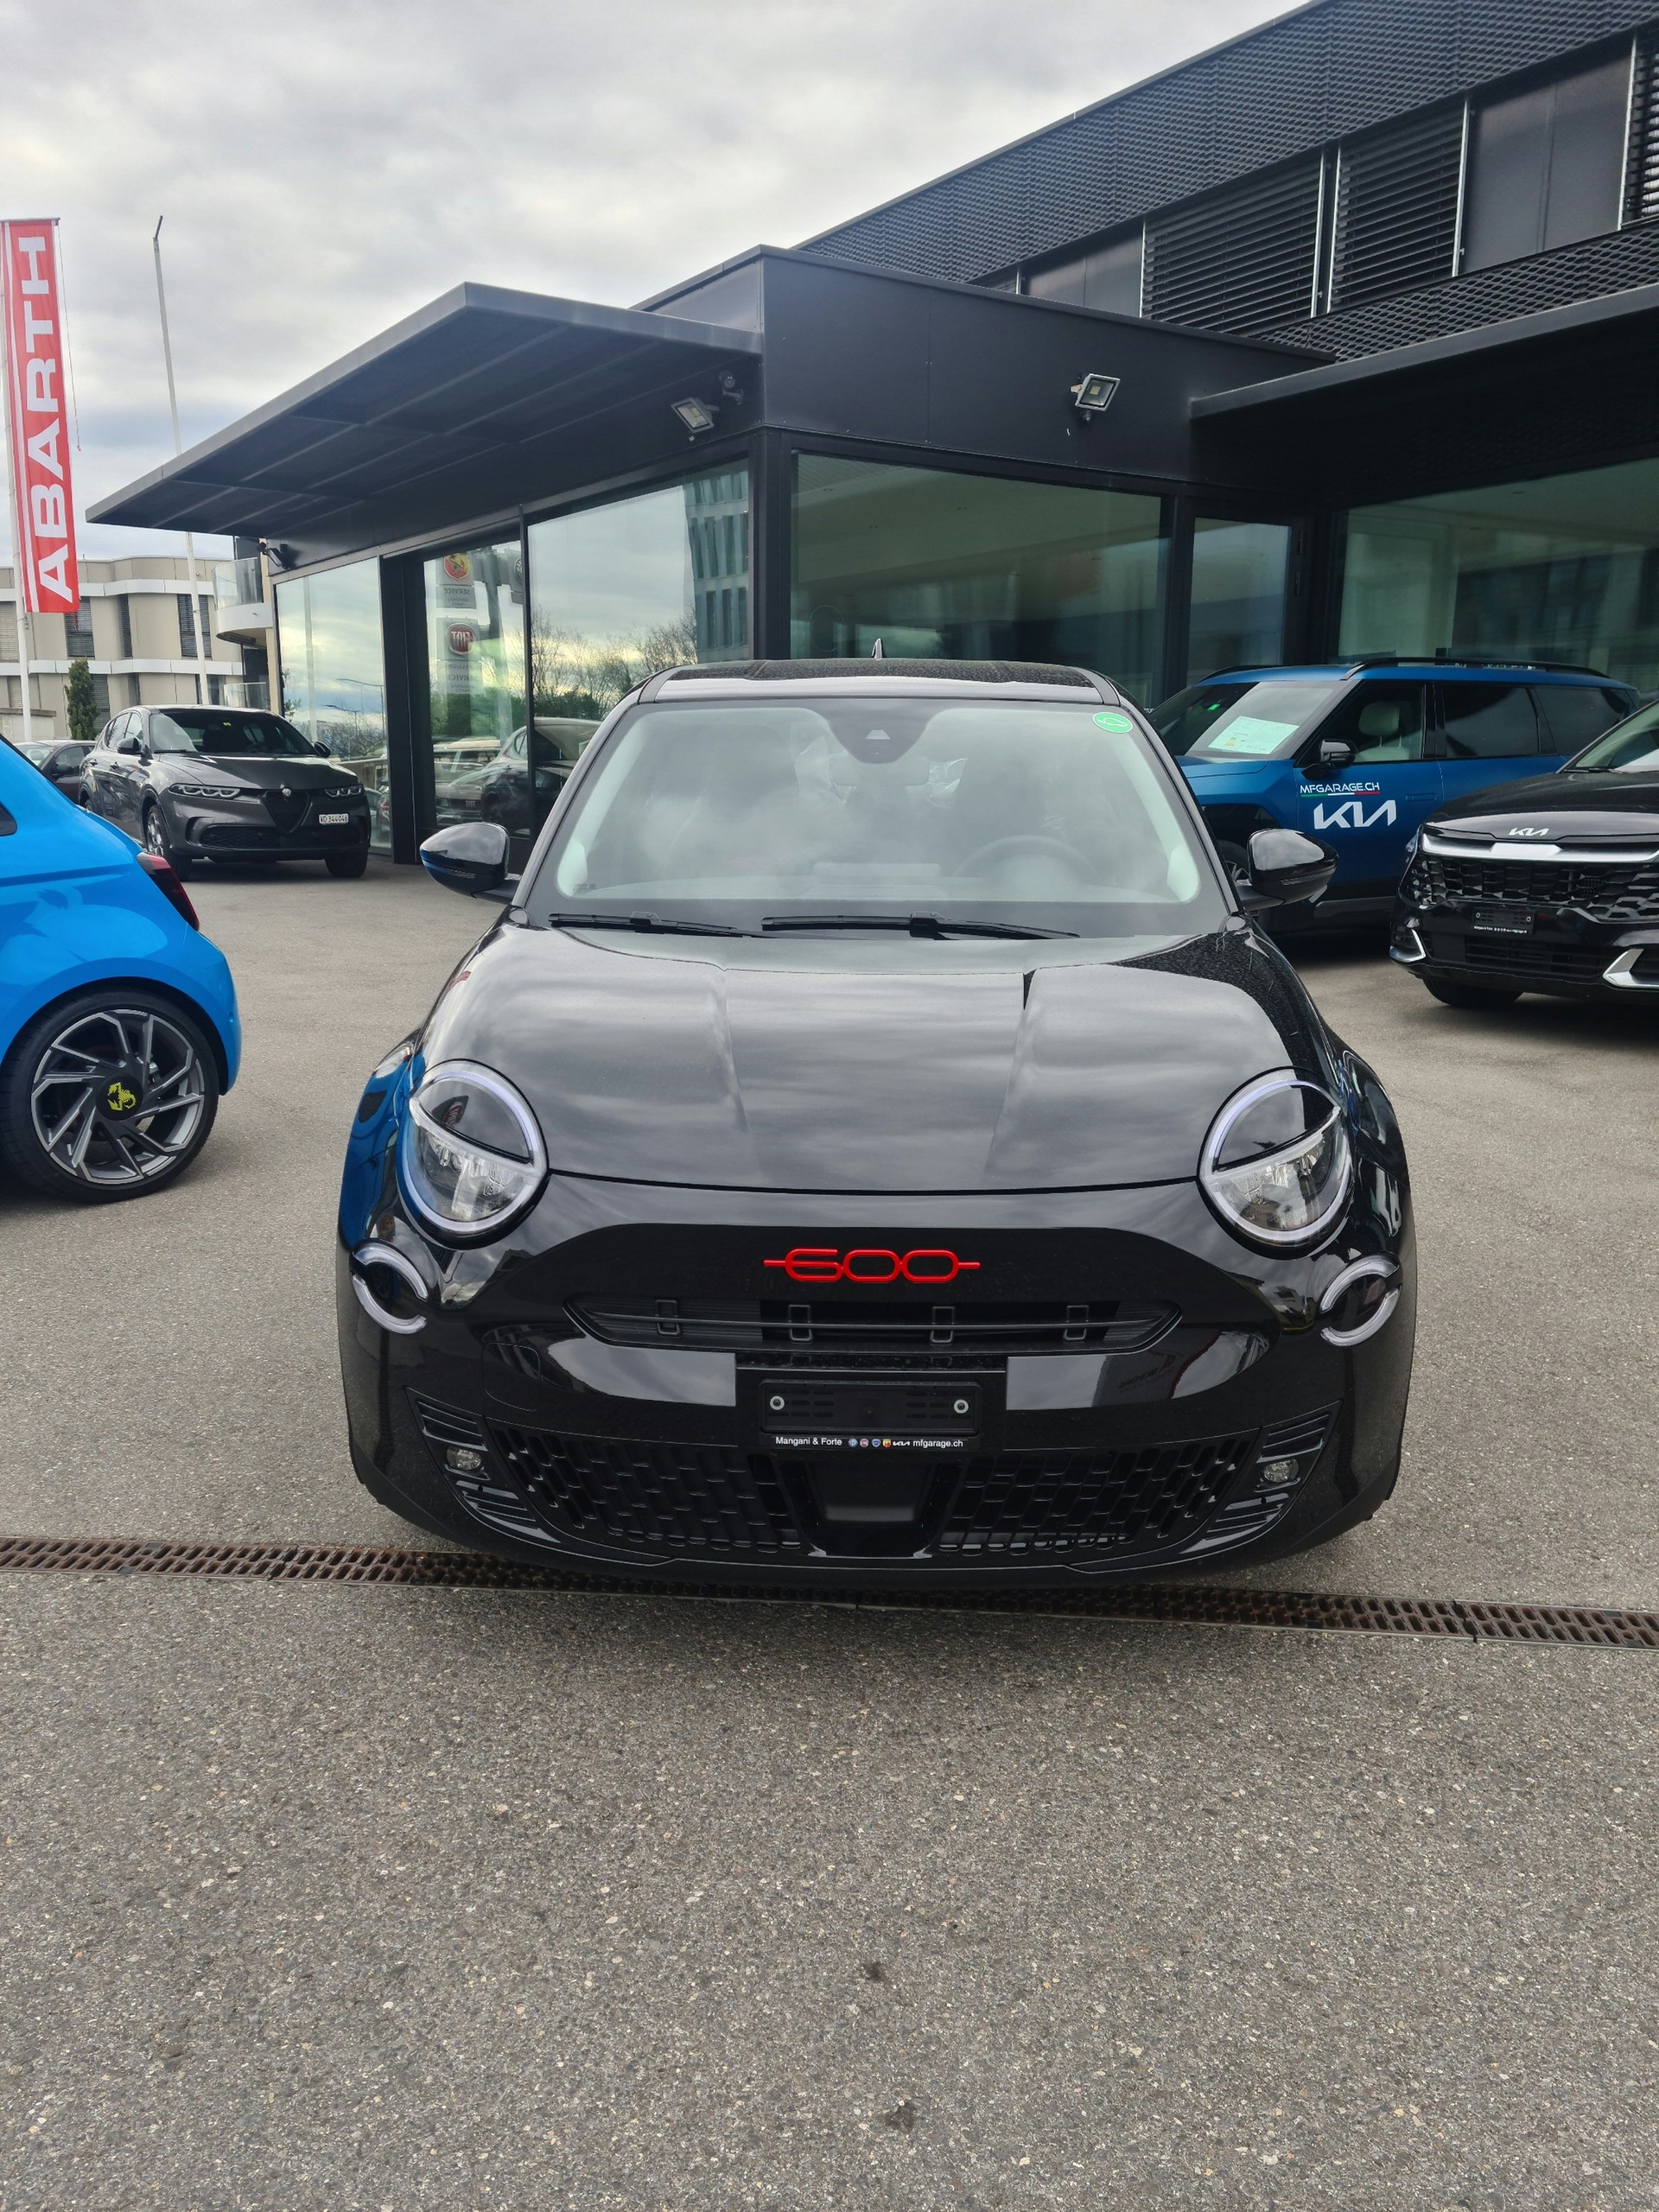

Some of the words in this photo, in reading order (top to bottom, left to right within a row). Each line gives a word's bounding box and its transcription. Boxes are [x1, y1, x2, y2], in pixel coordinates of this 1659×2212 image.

[17, 235, 73, 604] ABARTH
[1300, 782, 1380, 793] MFGARAGE.CH
[1313, 799, 1397, 830] KIA
[1509, 827, 1549, 836] KIA
[784, 1248, 960, 1283] 600
[775, 1436, 810, 1446] Mangani
[912, 1439, 963, 1449] mfgarage.ch
